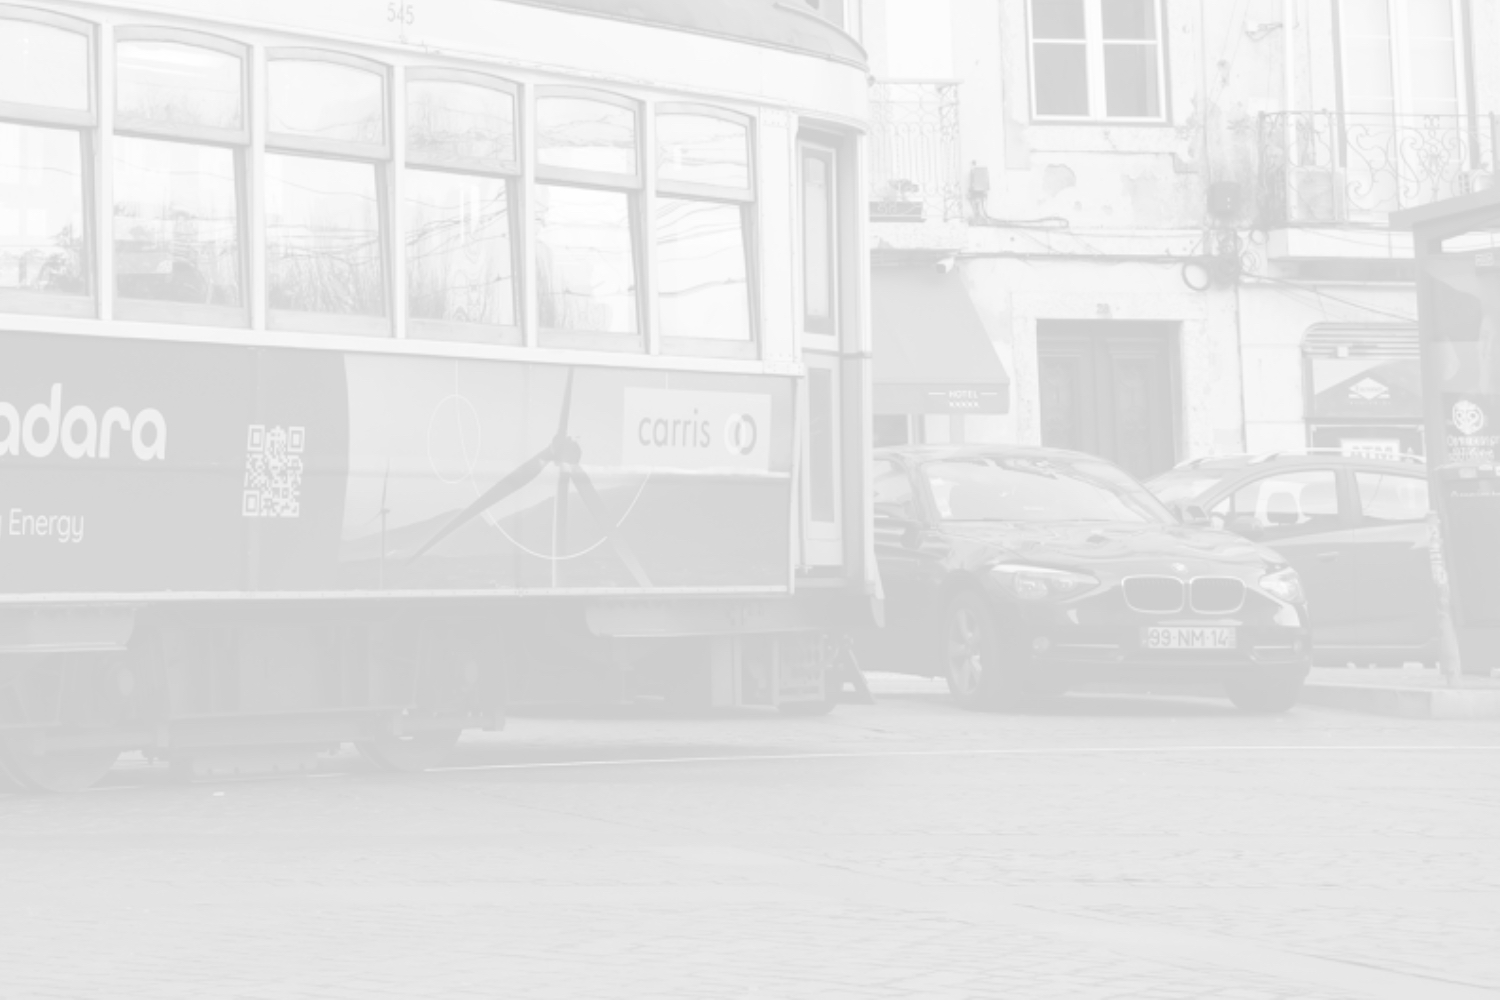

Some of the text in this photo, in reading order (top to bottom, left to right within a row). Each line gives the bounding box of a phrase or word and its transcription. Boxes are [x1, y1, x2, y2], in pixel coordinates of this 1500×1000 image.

[387, 2, 415, 25] 545
[948, 390, 979, 399] HOTEL
[638, 408, 711, 449] carris
[8, 508, 84, 542] Energy
[1149, 628, 1229, 647] 99-NM-14
